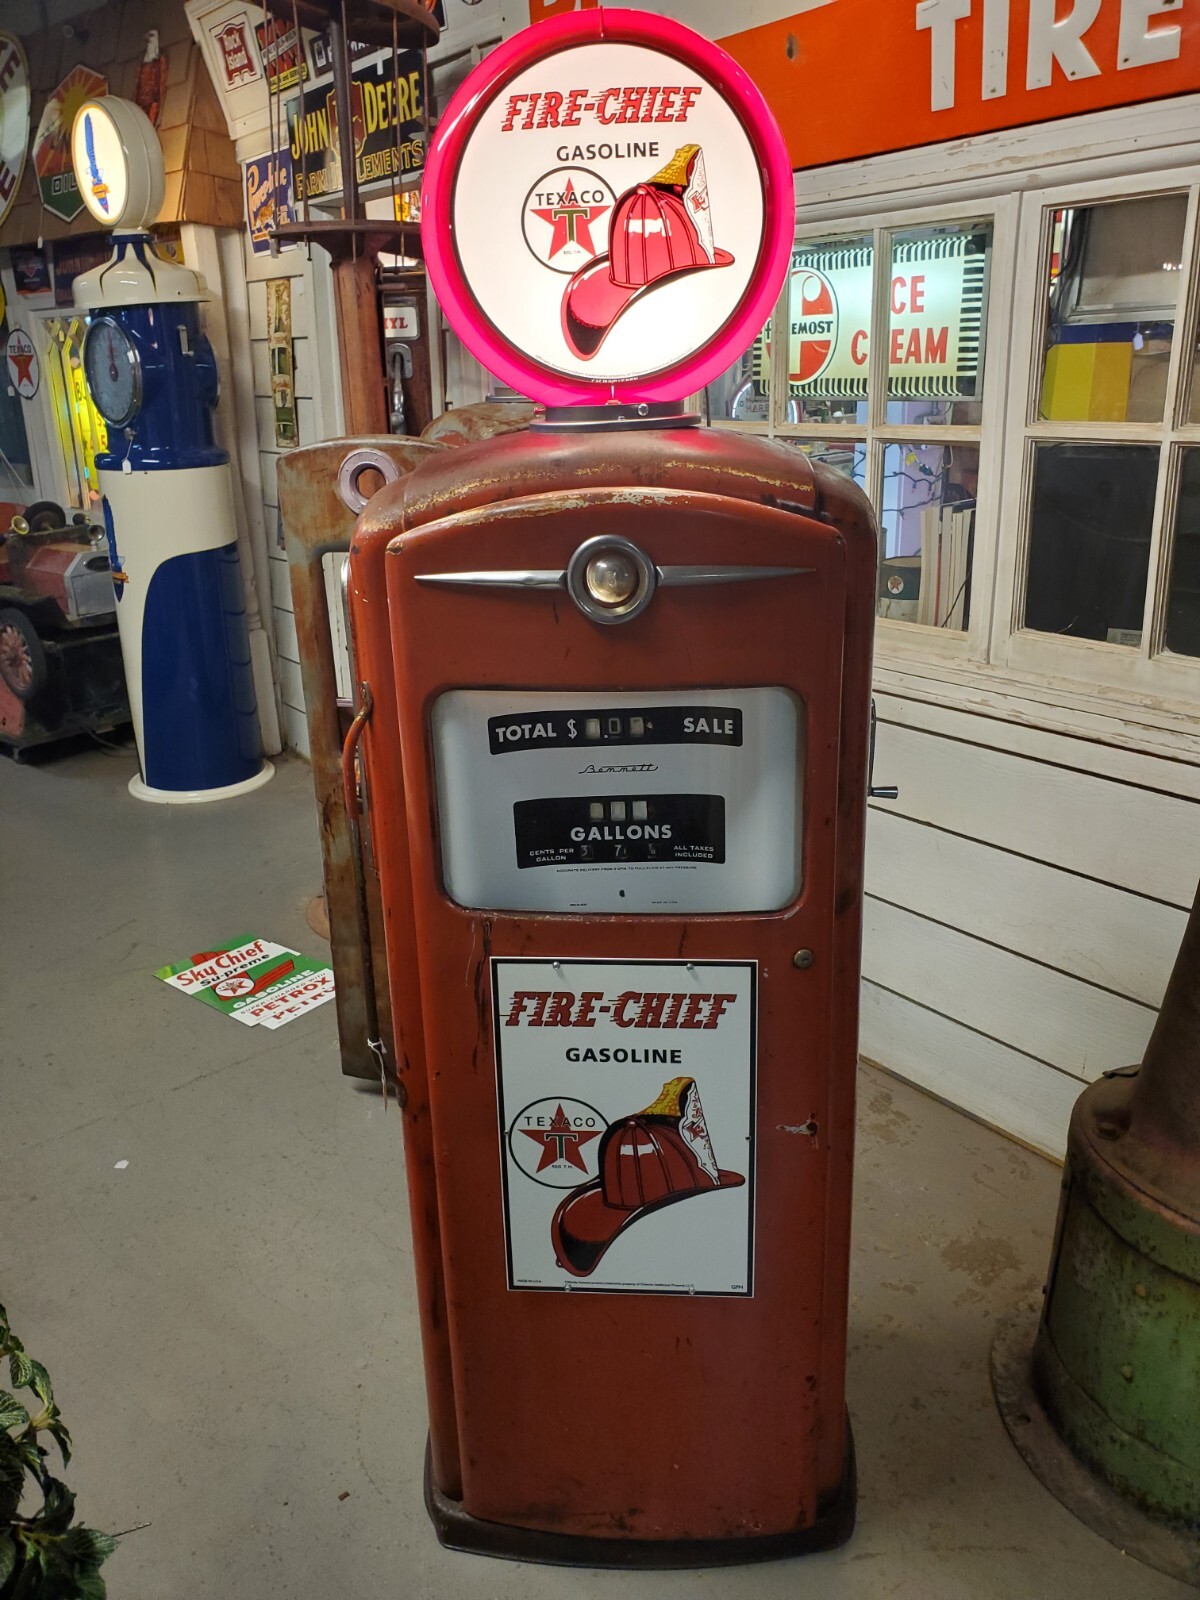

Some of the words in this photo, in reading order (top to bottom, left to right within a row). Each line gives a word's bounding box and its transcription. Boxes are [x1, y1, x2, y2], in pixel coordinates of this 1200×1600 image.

[916, 0, 1183, 112] TIRE
[363, 72, 422, 134] DEERE
[501, 86, 703, 132] FIRE-CHIEF
[330, 140, 424, 189] ILEMENTS
[556, 142, 659, 162] GASOLINE
[535, 190, 604, 206] TEXACO
[891, 275, 925, 314] CE
[764, 319, 834, 339] fEMOST
[851, 326, 949, 366] CEAM
[9, 344, 32, 354] TEXACO
[495, 722, 557, 742] TOTAL
[566, 719, 578, 739] $
[683, 717, 734, 734] SALE
[578, 763, 659, 775] Bennett
[570, 825, 672, 842] GALLONS
[176, 966, 216, 987] Sky
[215, 941, 265, 969] Chief
[200, 954, 270, 987] Su-preme
[233, 969, 315, 1009] GASOLINE
[251, 976, 332, 1017] PETROX
[503, 991, 738, 1029] FIRE-CHIEF
[565, 1047, 682, 1064] GASOLINE
[524, 1115, 596, 1129] TEXACO
